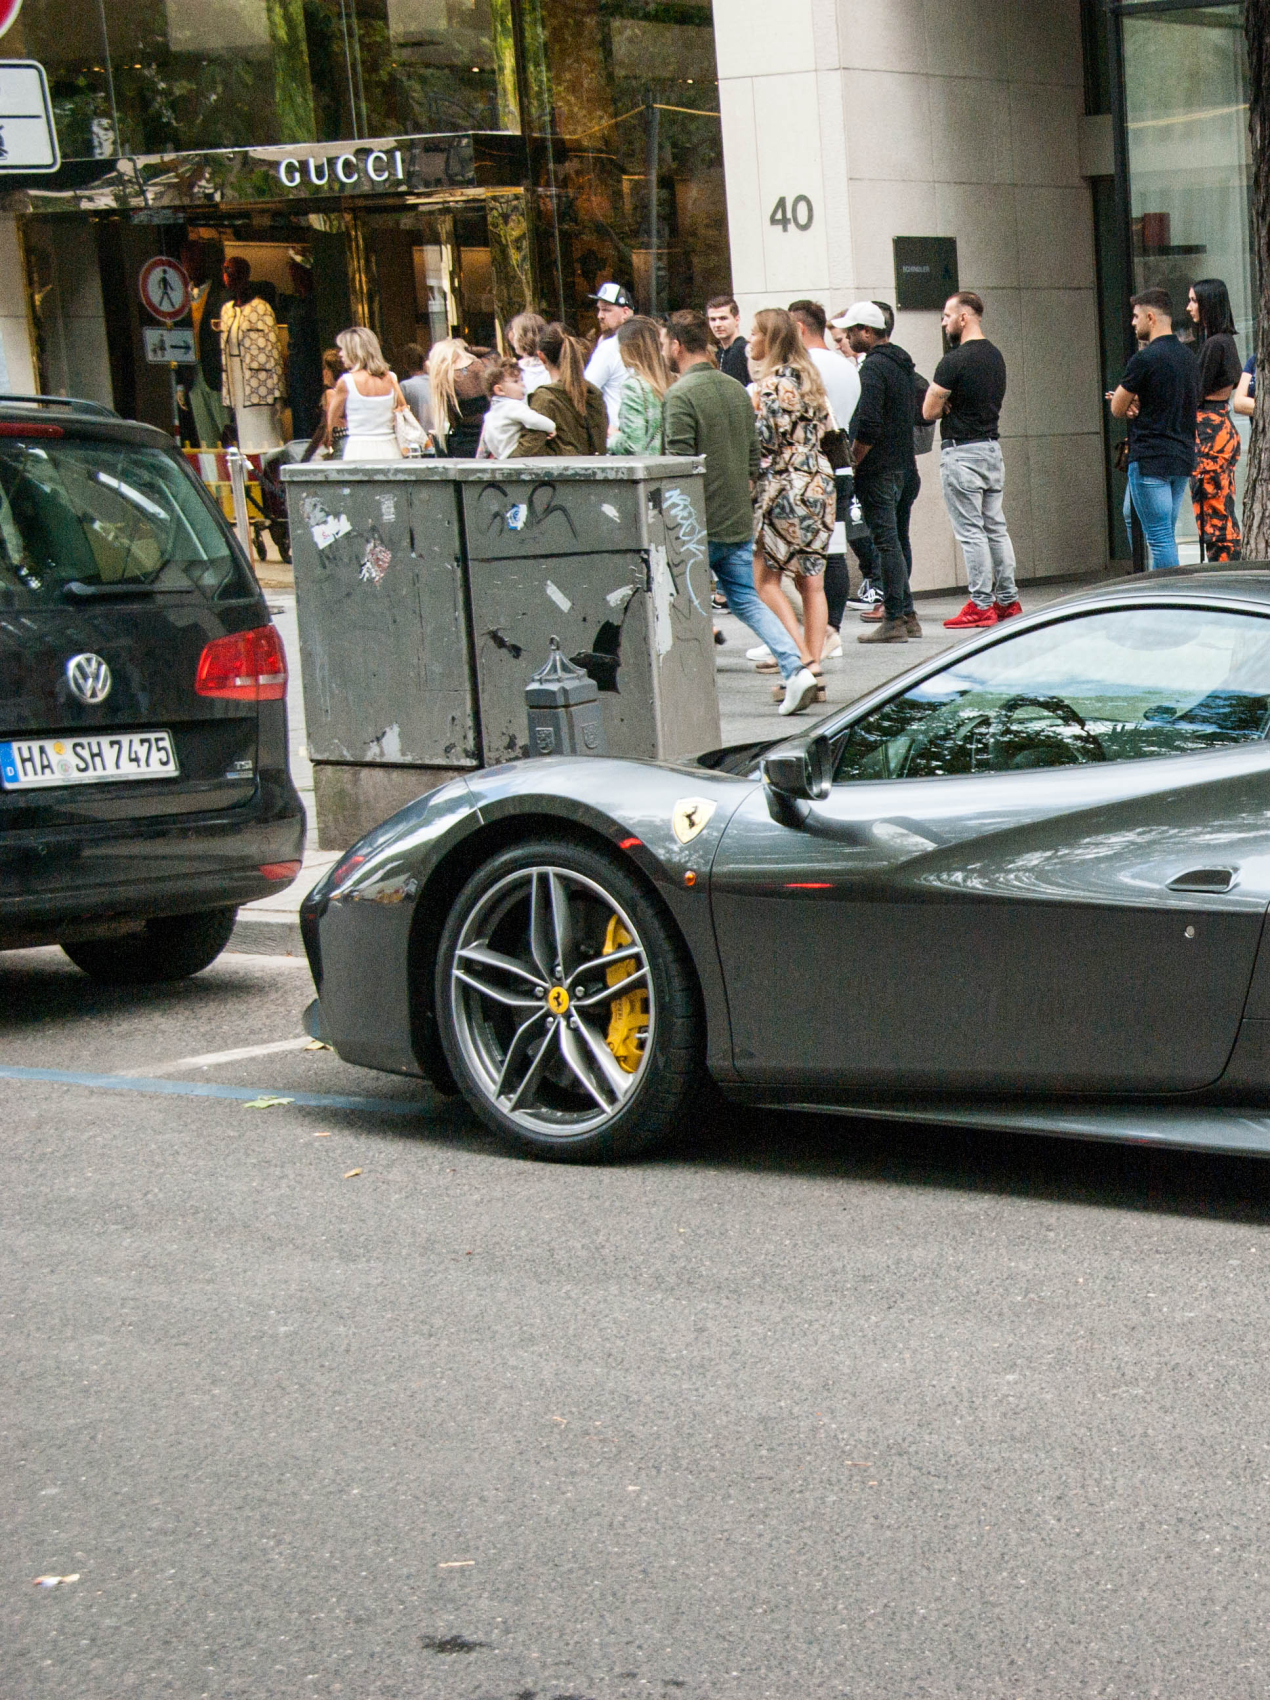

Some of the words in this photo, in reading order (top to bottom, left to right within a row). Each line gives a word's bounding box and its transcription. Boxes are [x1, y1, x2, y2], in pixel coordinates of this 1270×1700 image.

[279, 151, 404, 187] GUCCI
[769, 194, 814, 233] 40
[6, 766, 15, 777] D
[18, 744, 55, 777] HA
[72, 741, 107, 773] SH
[109, 737, 171, 770] 7475
